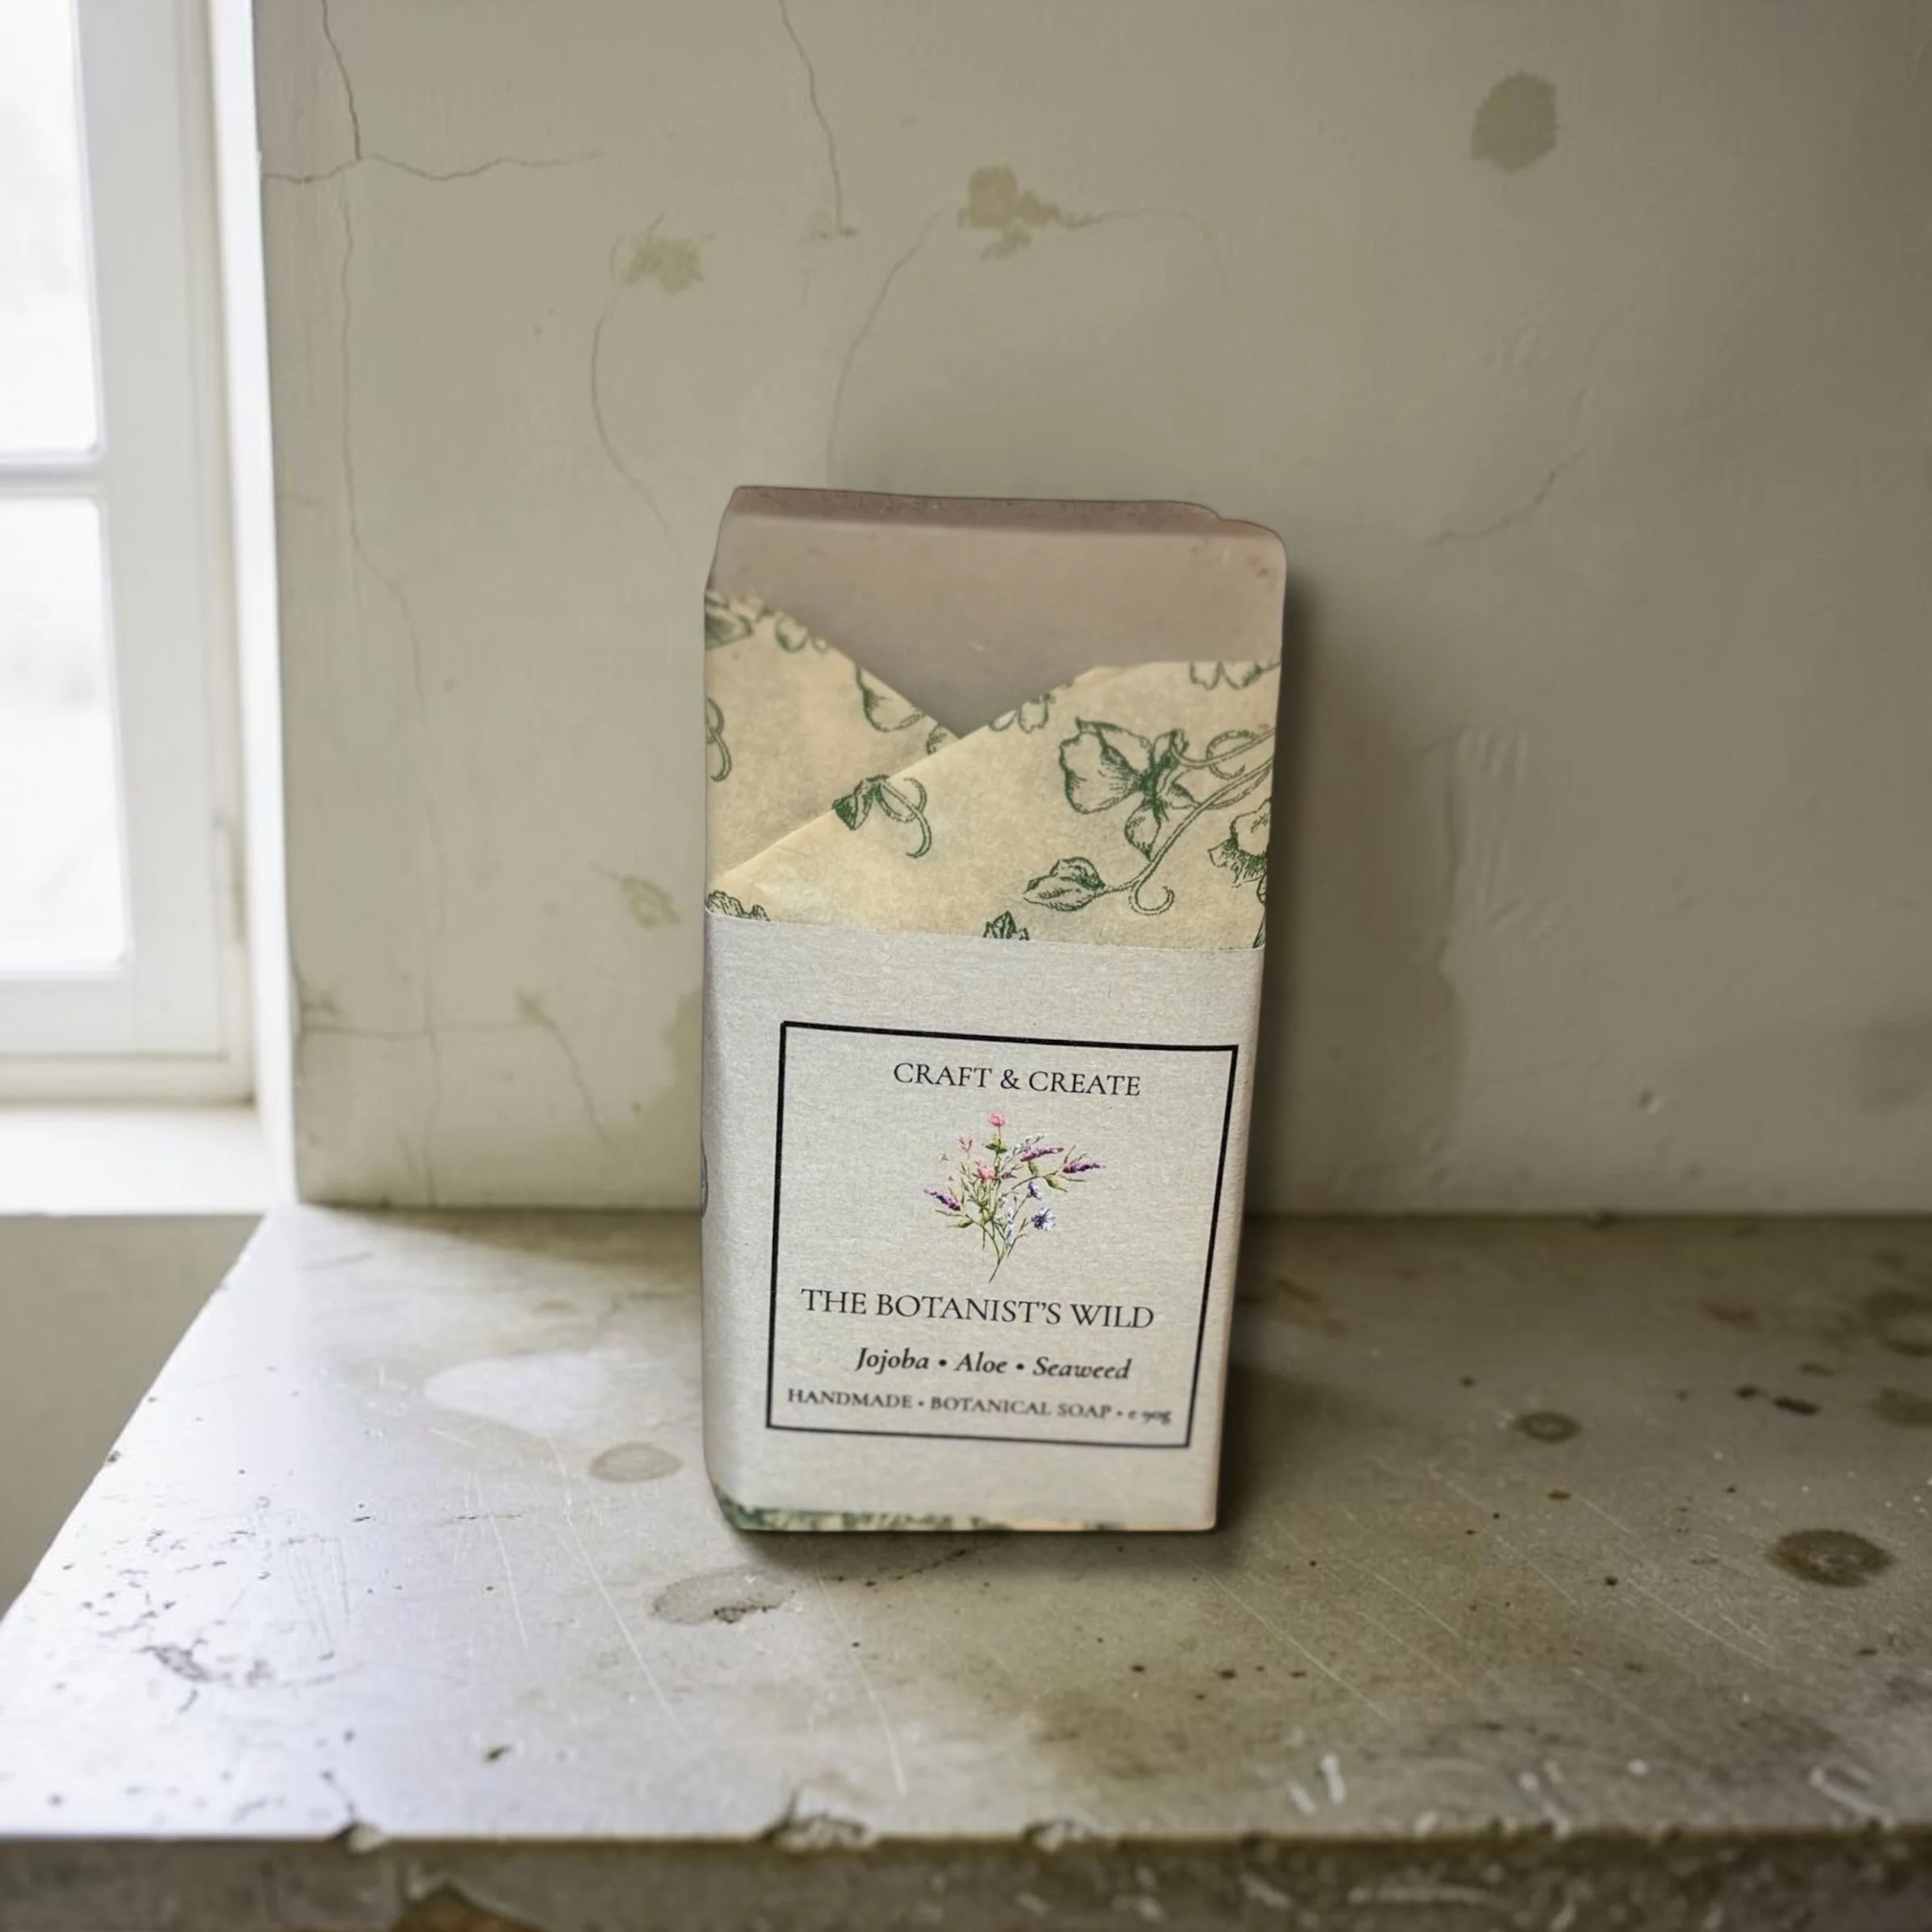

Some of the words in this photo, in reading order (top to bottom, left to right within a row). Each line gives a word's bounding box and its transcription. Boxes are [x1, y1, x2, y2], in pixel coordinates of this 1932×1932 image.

[893, 1061, 993, 1090] CRAFT
[998, 1067, 1022, 1092] &
[1027, 1069, 1141, 1097] CREATE
[799, 1287, 868, 1316] THE
[875, 1292, 1063, 1327] BOTANIST'S
[1069, 1302, 1156, 1330] WILD
[853, 1346, 931, 1375] Jojoba
[953, 1349, 1009, 1375] Aloe
[1031, 1356, 1133, 1381] Seaweed
[786, 1387, 913, 1410] HANDMADE
[930, 1395, 1053, 1417] BOTANICAL
[1056, 1402, 1112, 1420] SOAP
